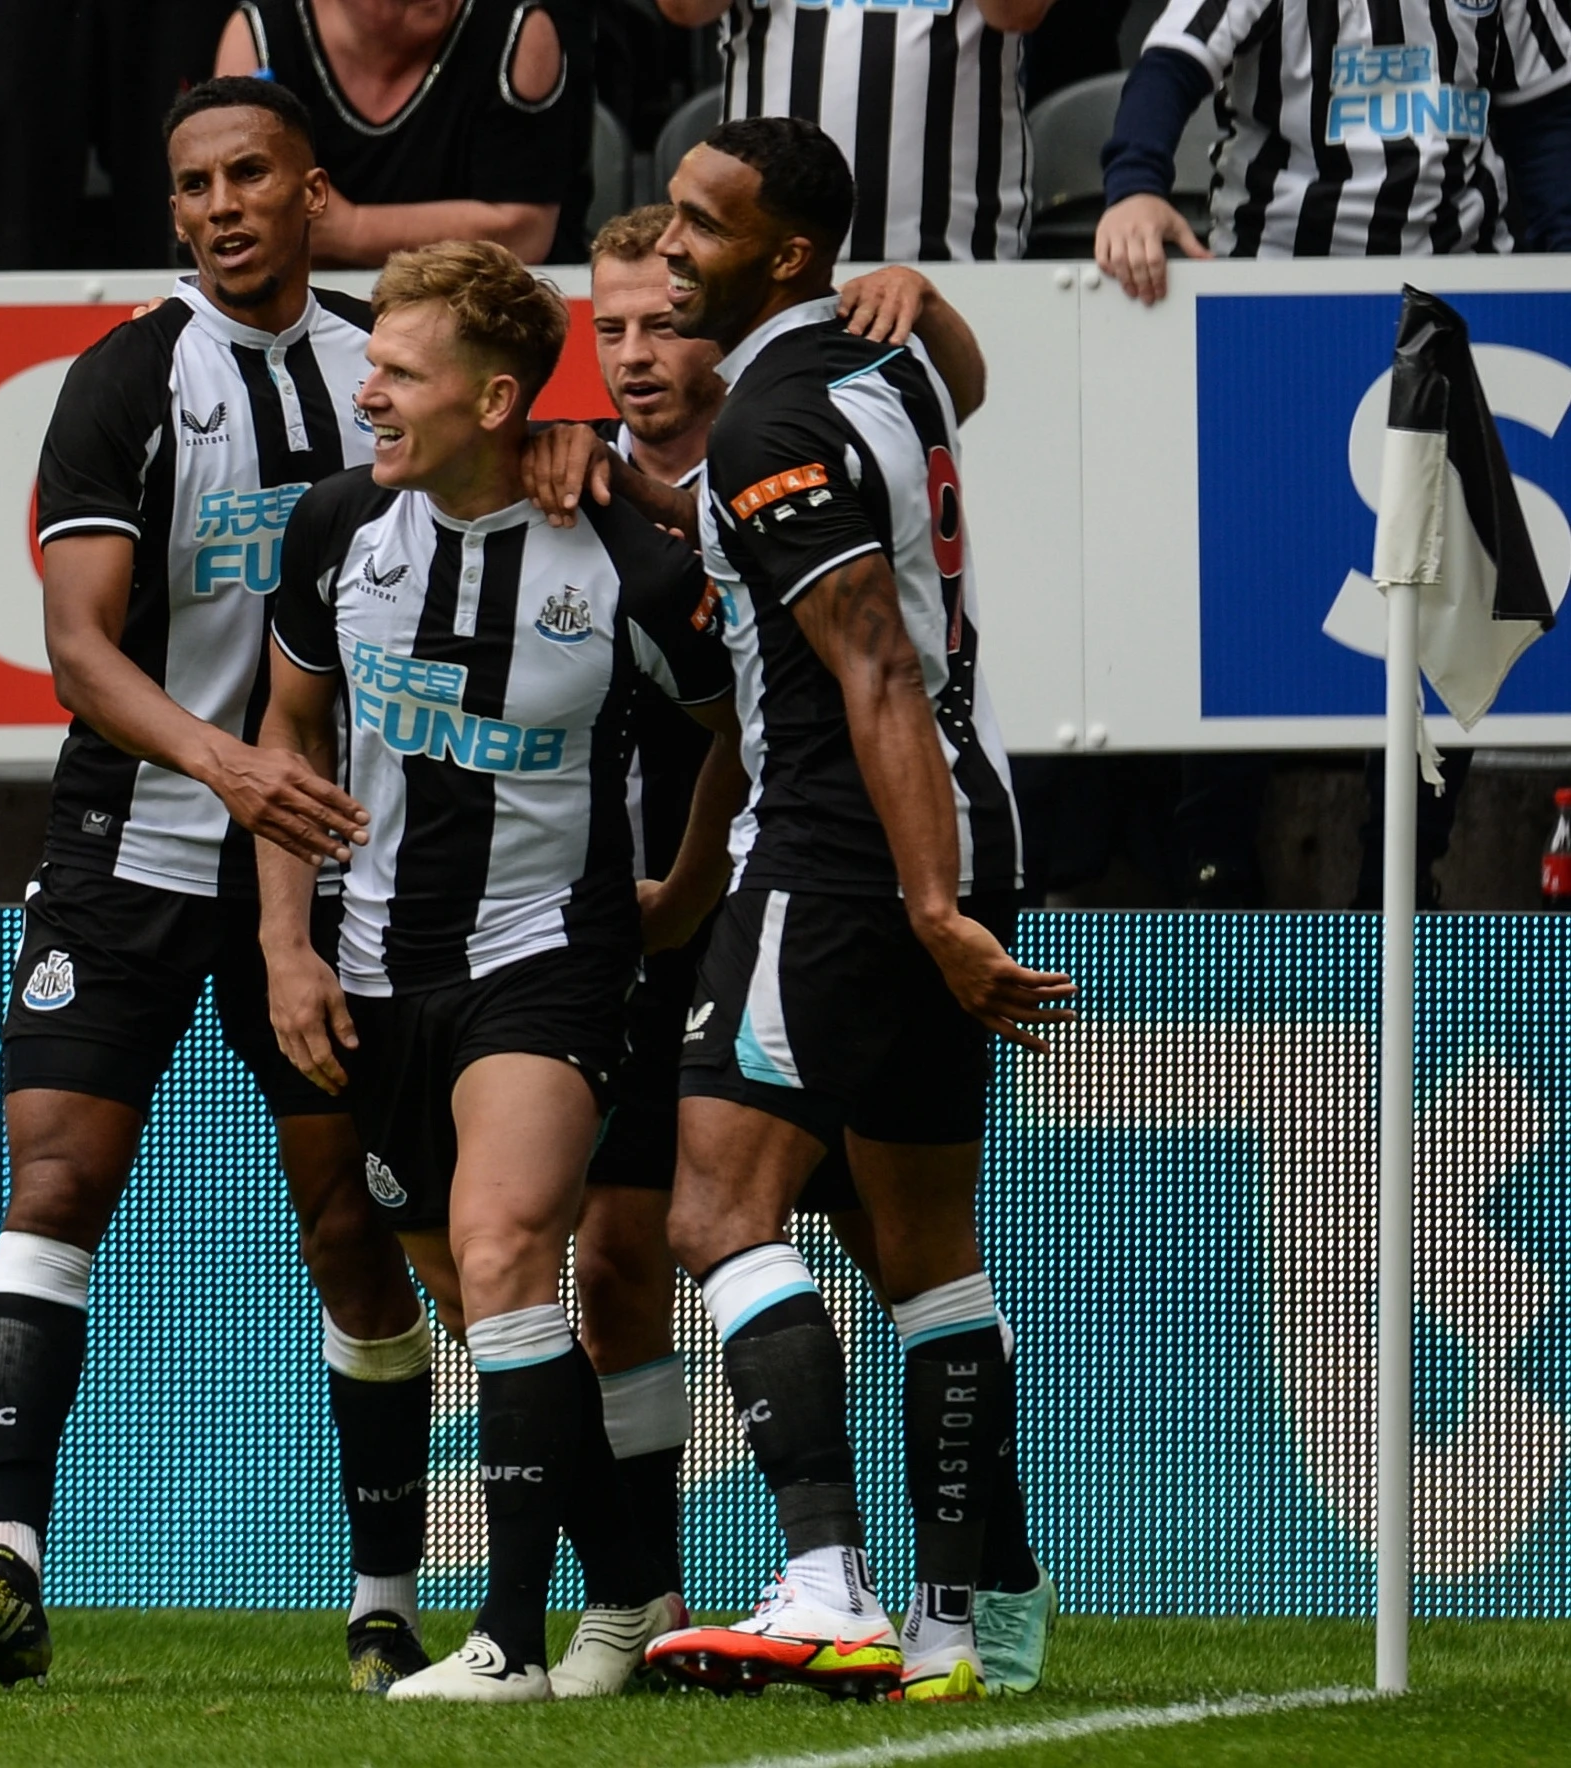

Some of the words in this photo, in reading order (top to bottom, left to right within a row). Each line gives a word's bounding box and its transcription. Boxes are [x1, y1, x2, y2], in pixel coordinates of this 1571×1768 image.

[185, 434, 230, 447] CASTORE
[738, 469, 821, 513] KAYAK
[356, 582, 397, 604] CASTORE
[351, 641, 464, 706] 乐天堂
[354, 688, 567, 772] FUN88
[937, 1362, 978, 1522] CASTORE
